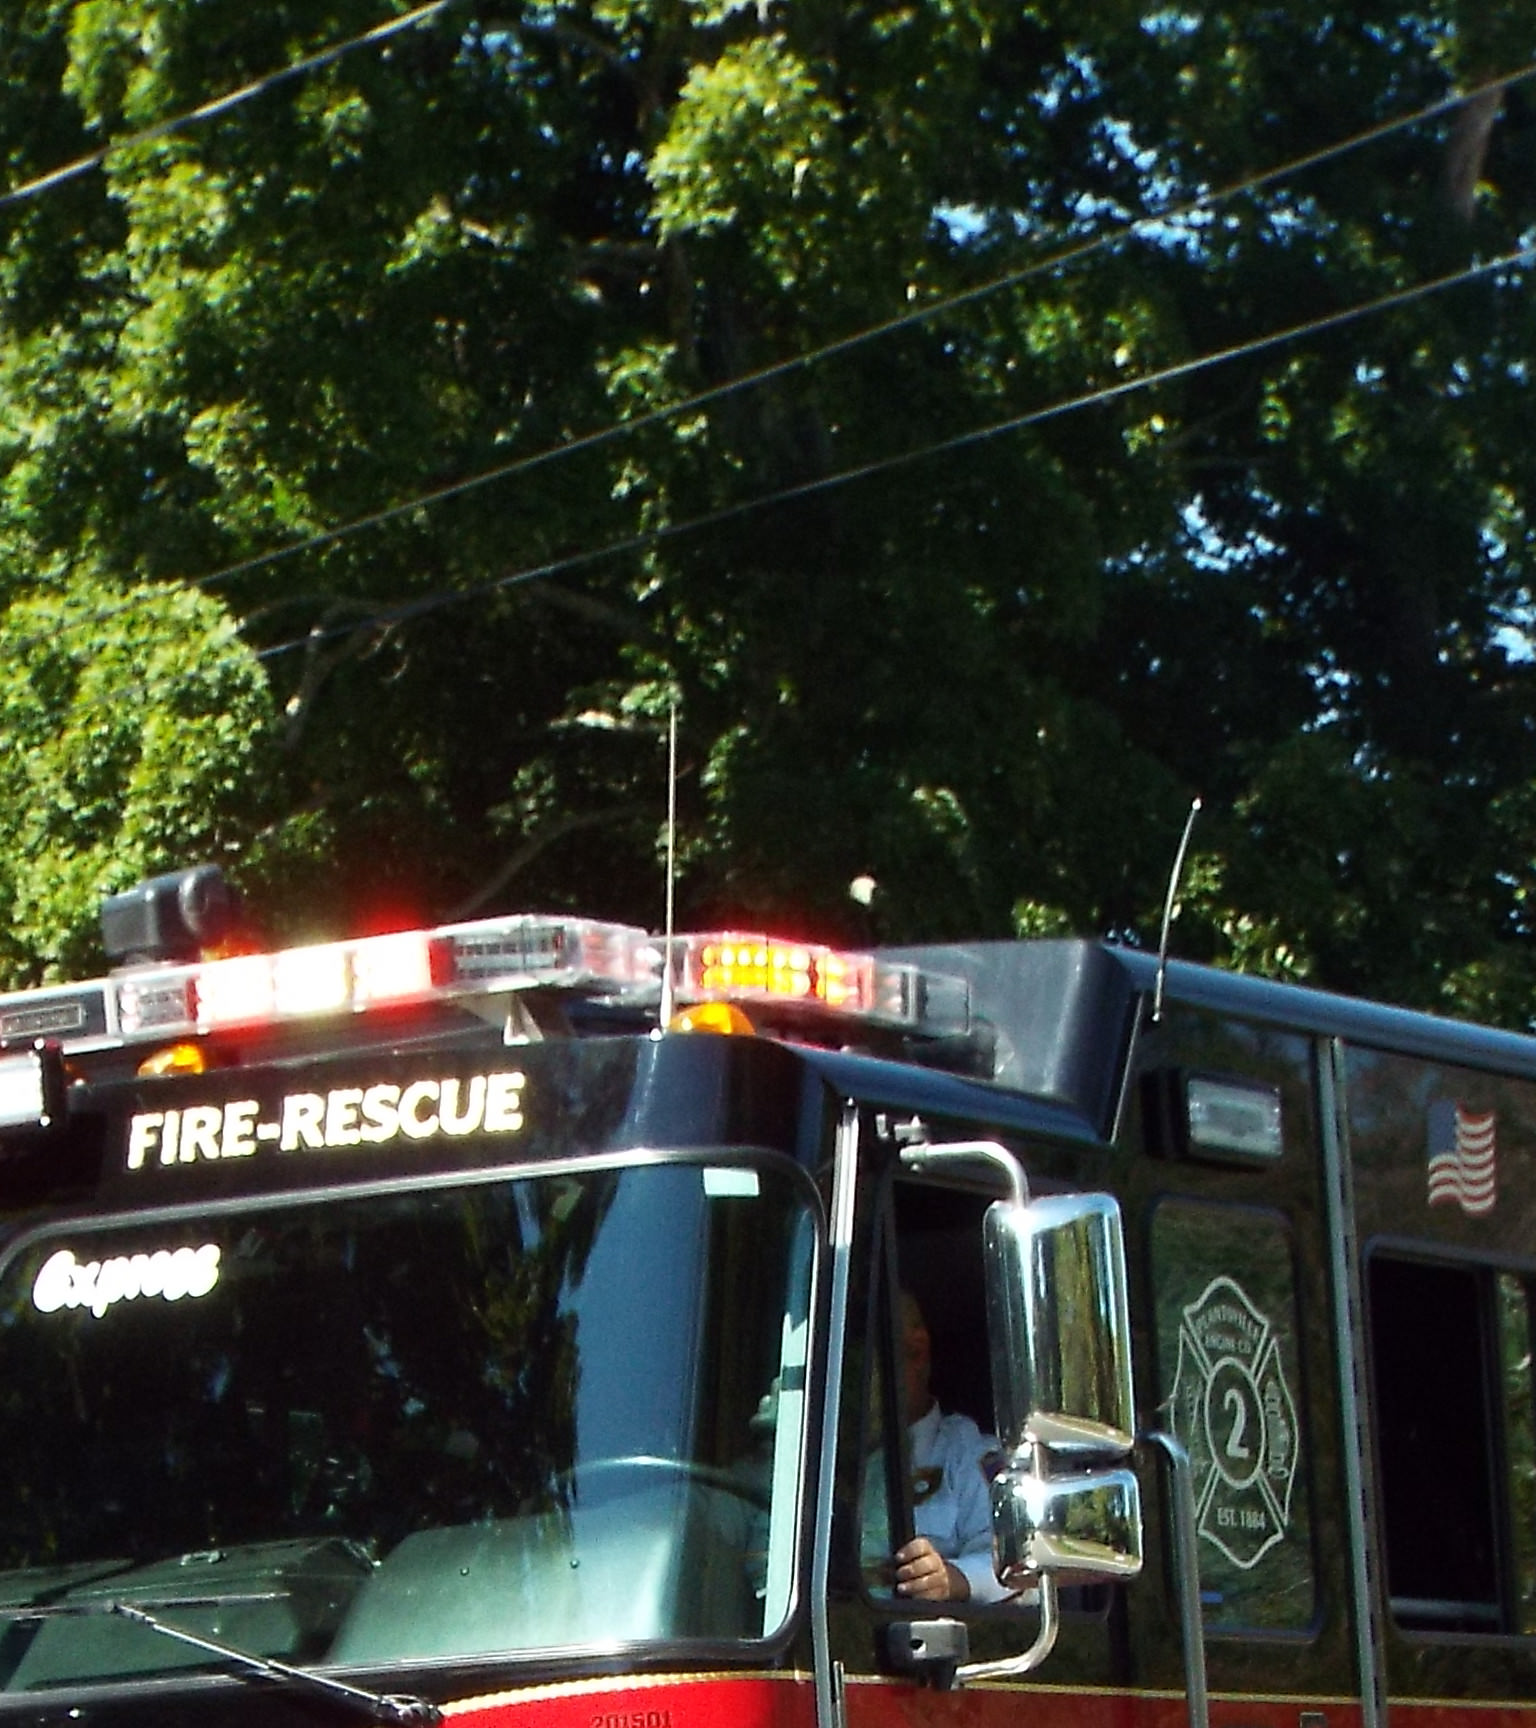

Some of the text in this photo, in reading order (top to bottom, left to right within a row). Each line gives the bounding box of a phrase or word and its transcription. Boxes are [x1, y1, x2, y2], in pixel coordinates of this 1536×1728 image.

[126, 1072, 526, 1171] FIRE-RESCUE
[32, 1243, 221, 1318] Express
[1223, 1387, 1249, 1459] 2
